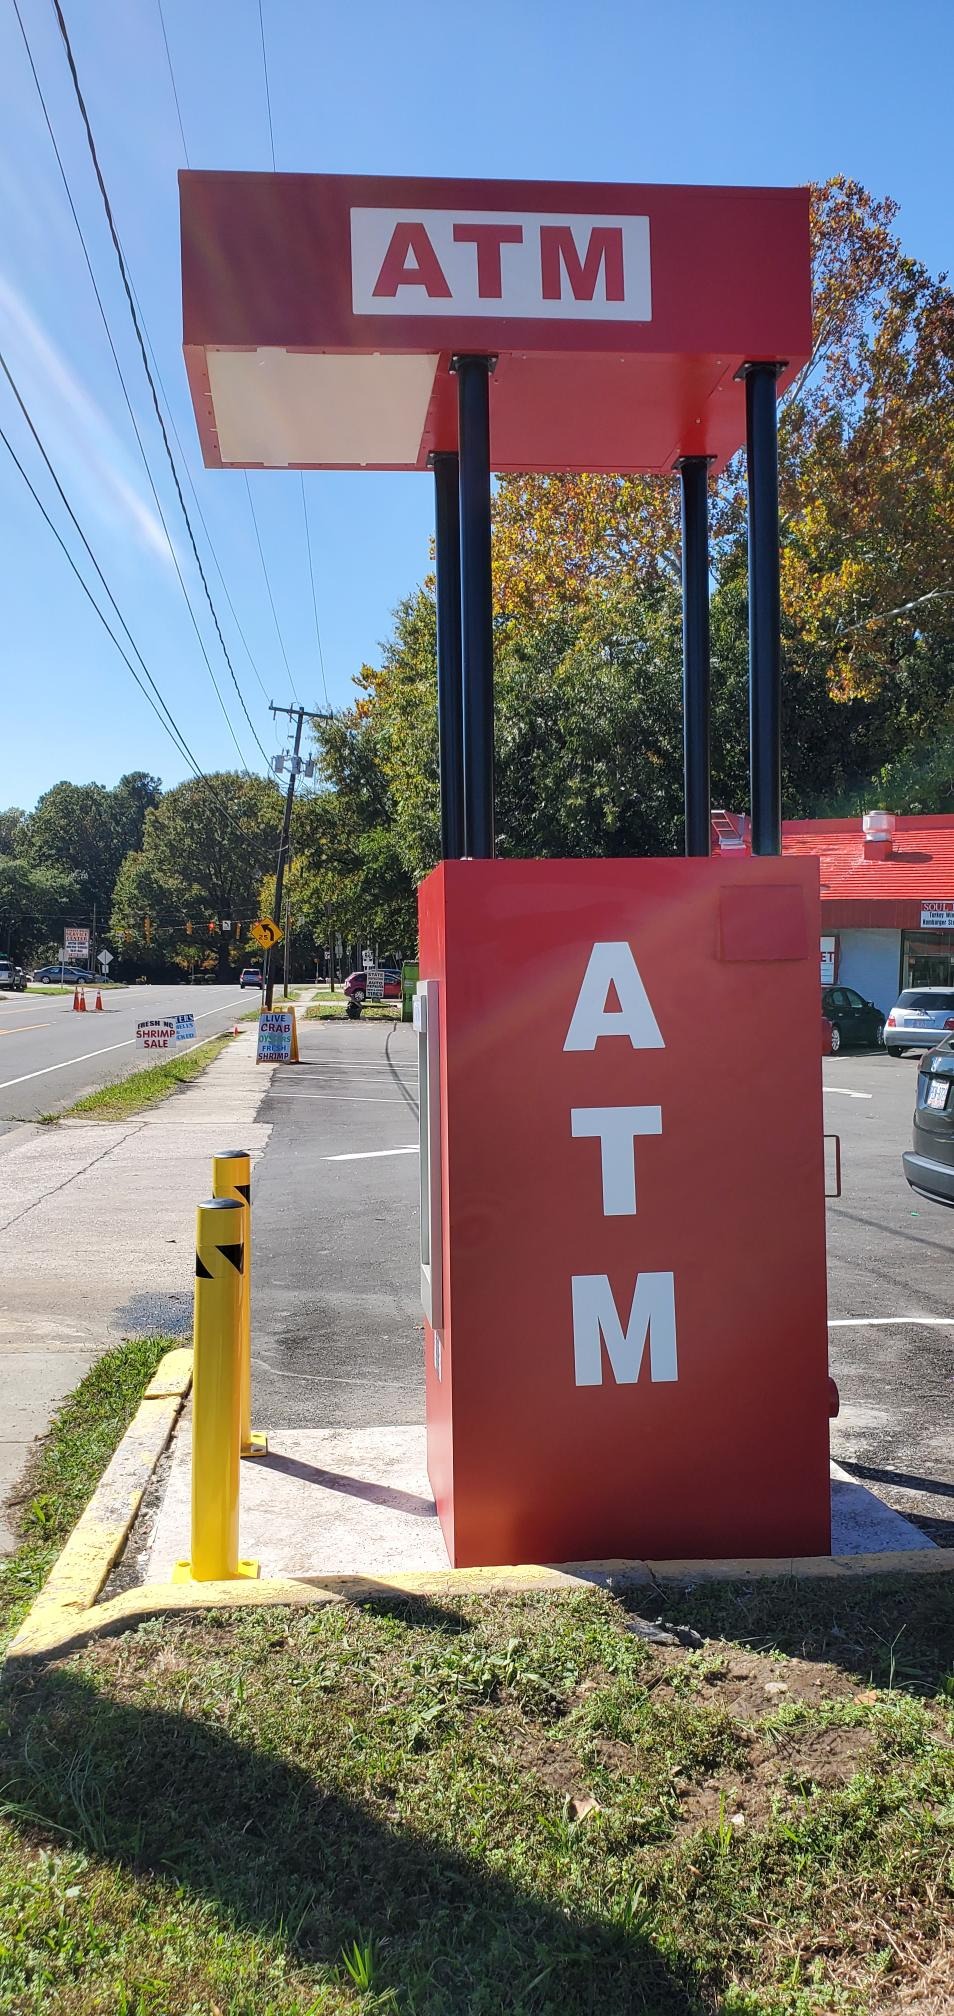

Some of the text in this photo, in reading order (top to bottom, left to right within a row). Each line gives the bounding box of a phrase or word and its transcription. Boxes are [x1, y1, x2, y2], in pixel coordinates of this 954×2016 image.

[372, 222, 625, 301] ATM
[923, 903, 948, 911] SOUL
[265, 1014, 286, 1023] LIVE
[137, 1020, 174, 1030] FRESH NC
[260, 1023, 291, 1033] CRAB
[136, 1029, 176, 1039] SHRIMP
[143, 1039, 169, 1049] SALE
[258, 1052, 289, 1060] SHRIMP
[563, 941, 679, 1387] ATM
